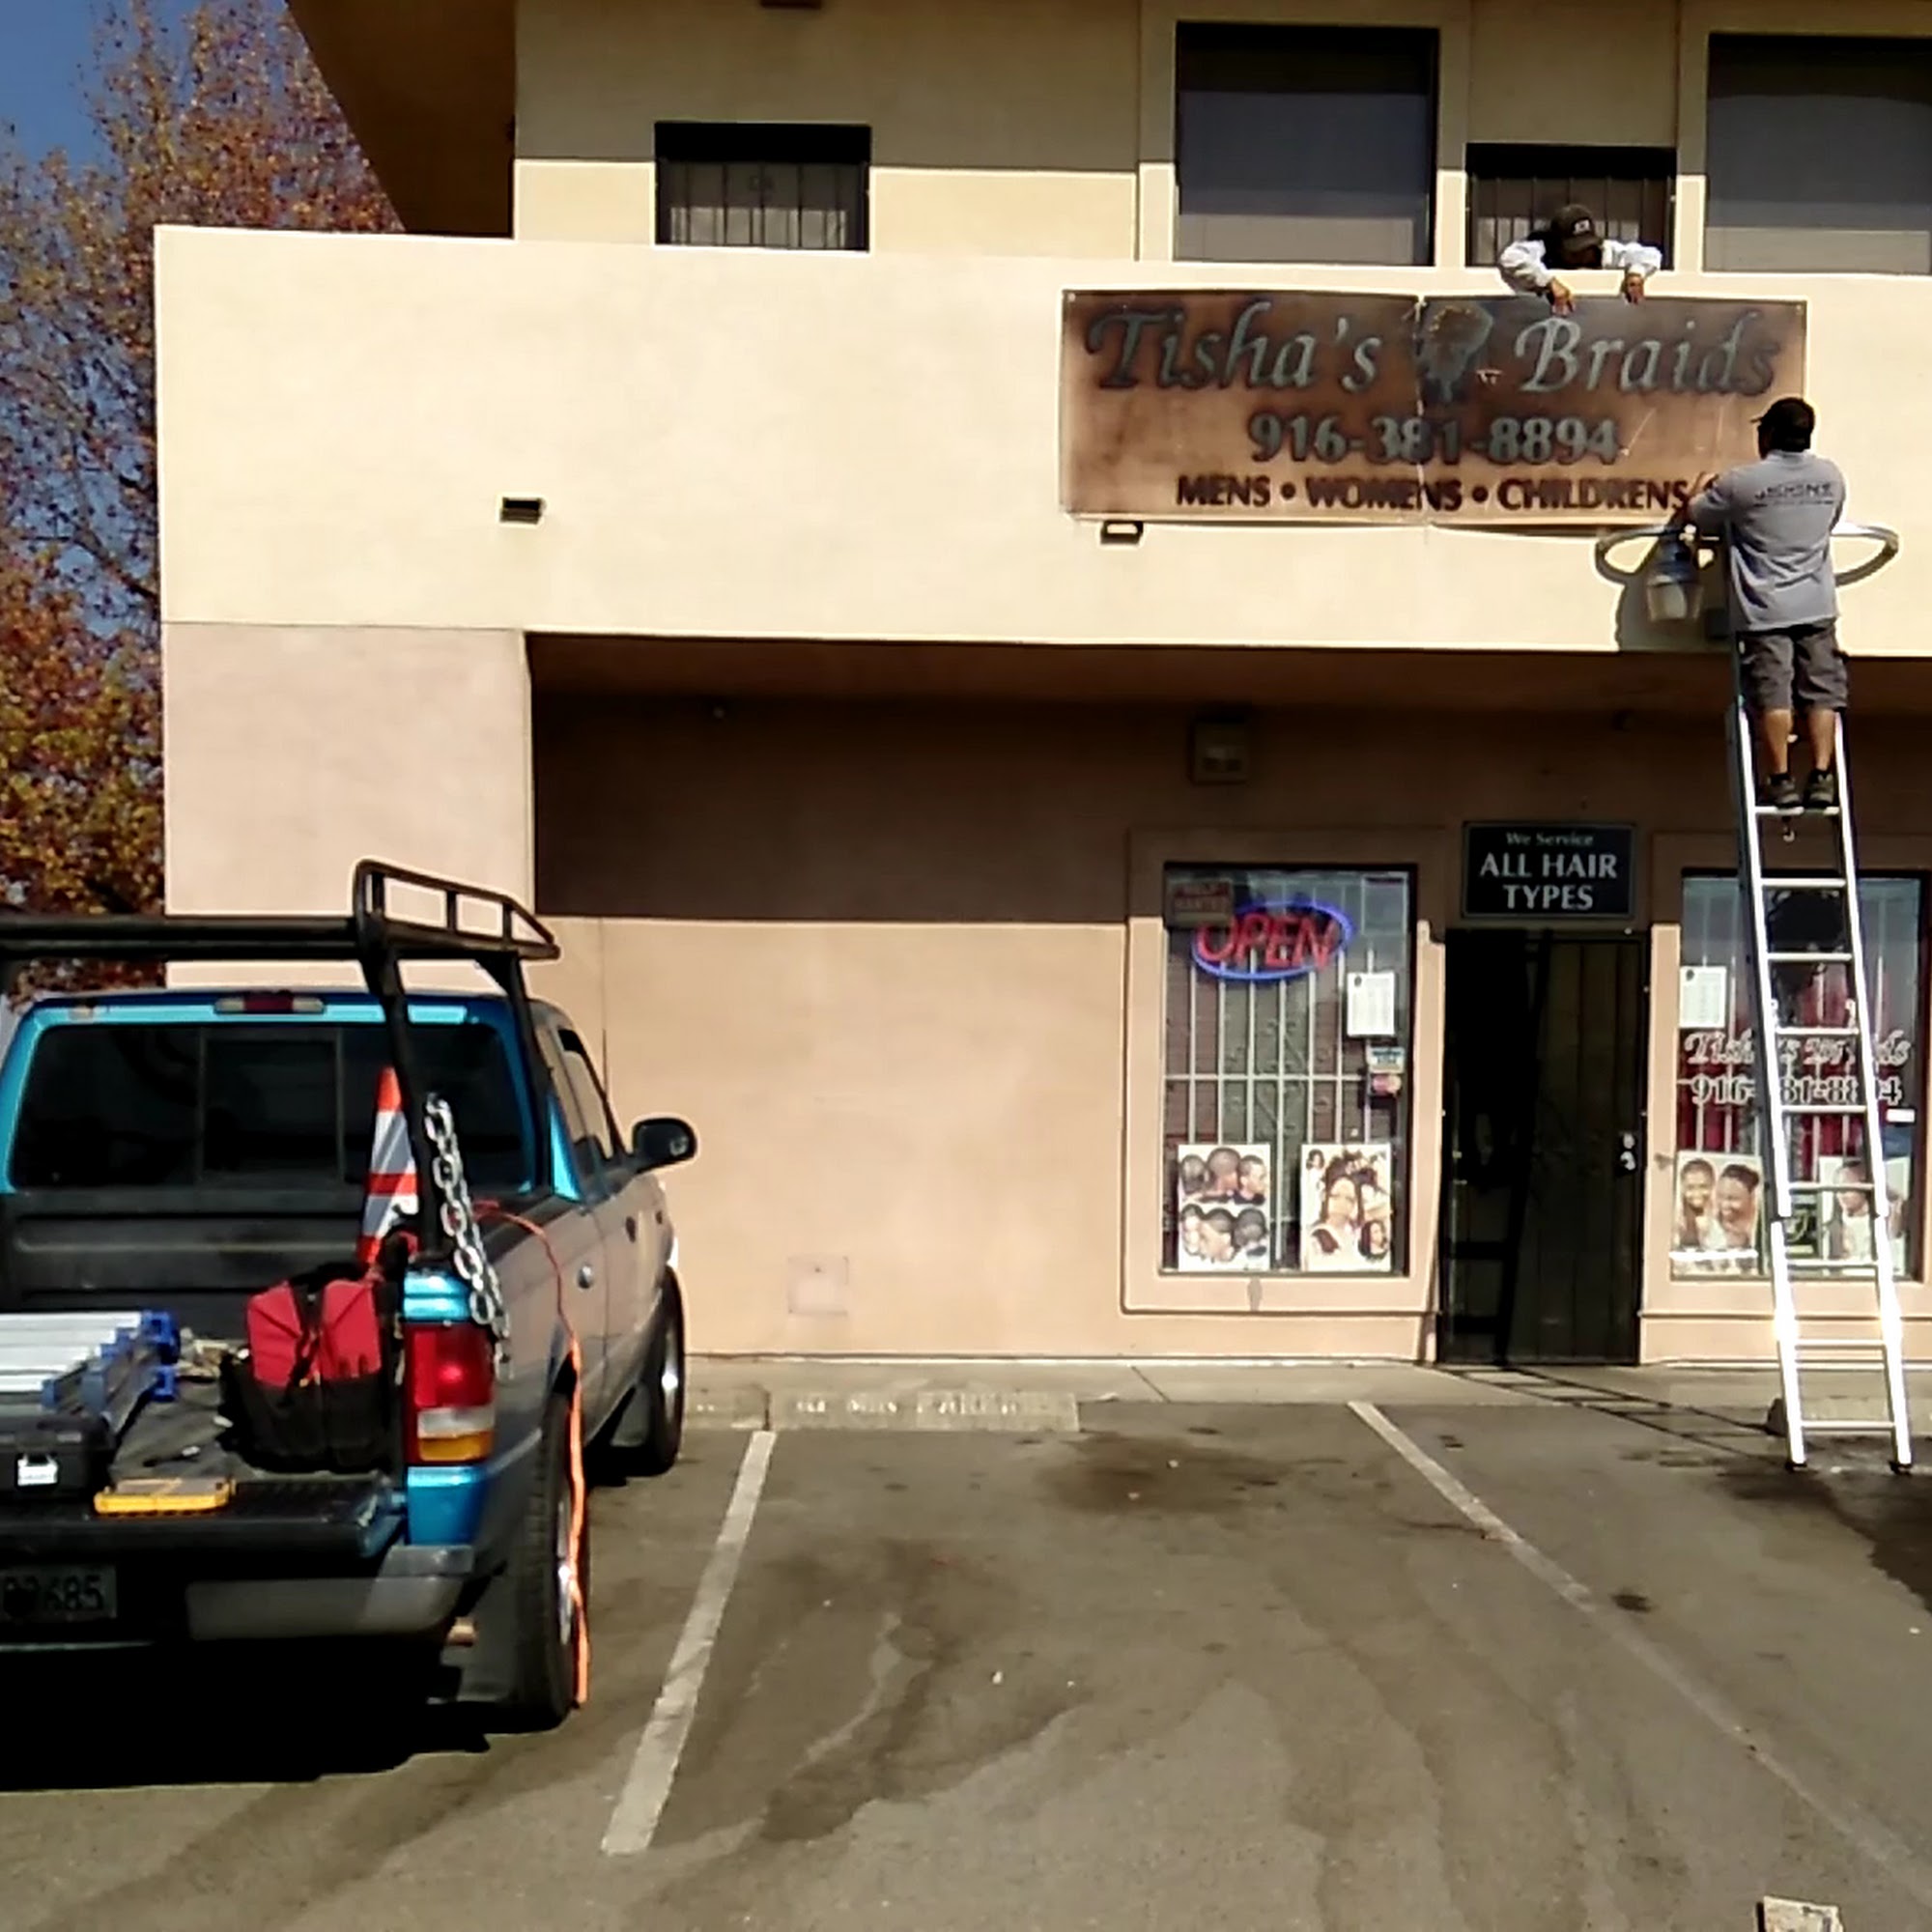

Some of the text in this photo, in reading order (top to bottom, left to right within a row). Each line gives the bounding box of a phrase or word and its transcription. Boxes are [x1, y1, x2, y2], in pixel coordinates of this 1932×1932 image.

[1084, 300, 1781, 395] Tisha's Braids
[1248, 412, 1621, 467] 916-381-8894
[1176, 474, 1689, 512] MENS WOMENS CHILDRENS
[1506, 831, 1594, 846] We Service
[1479, 851, 1618, 879] ALL HAIR
[1502, 884, 1594, 910] TYPES
[1196, 913, 1340, 971] OPEN
